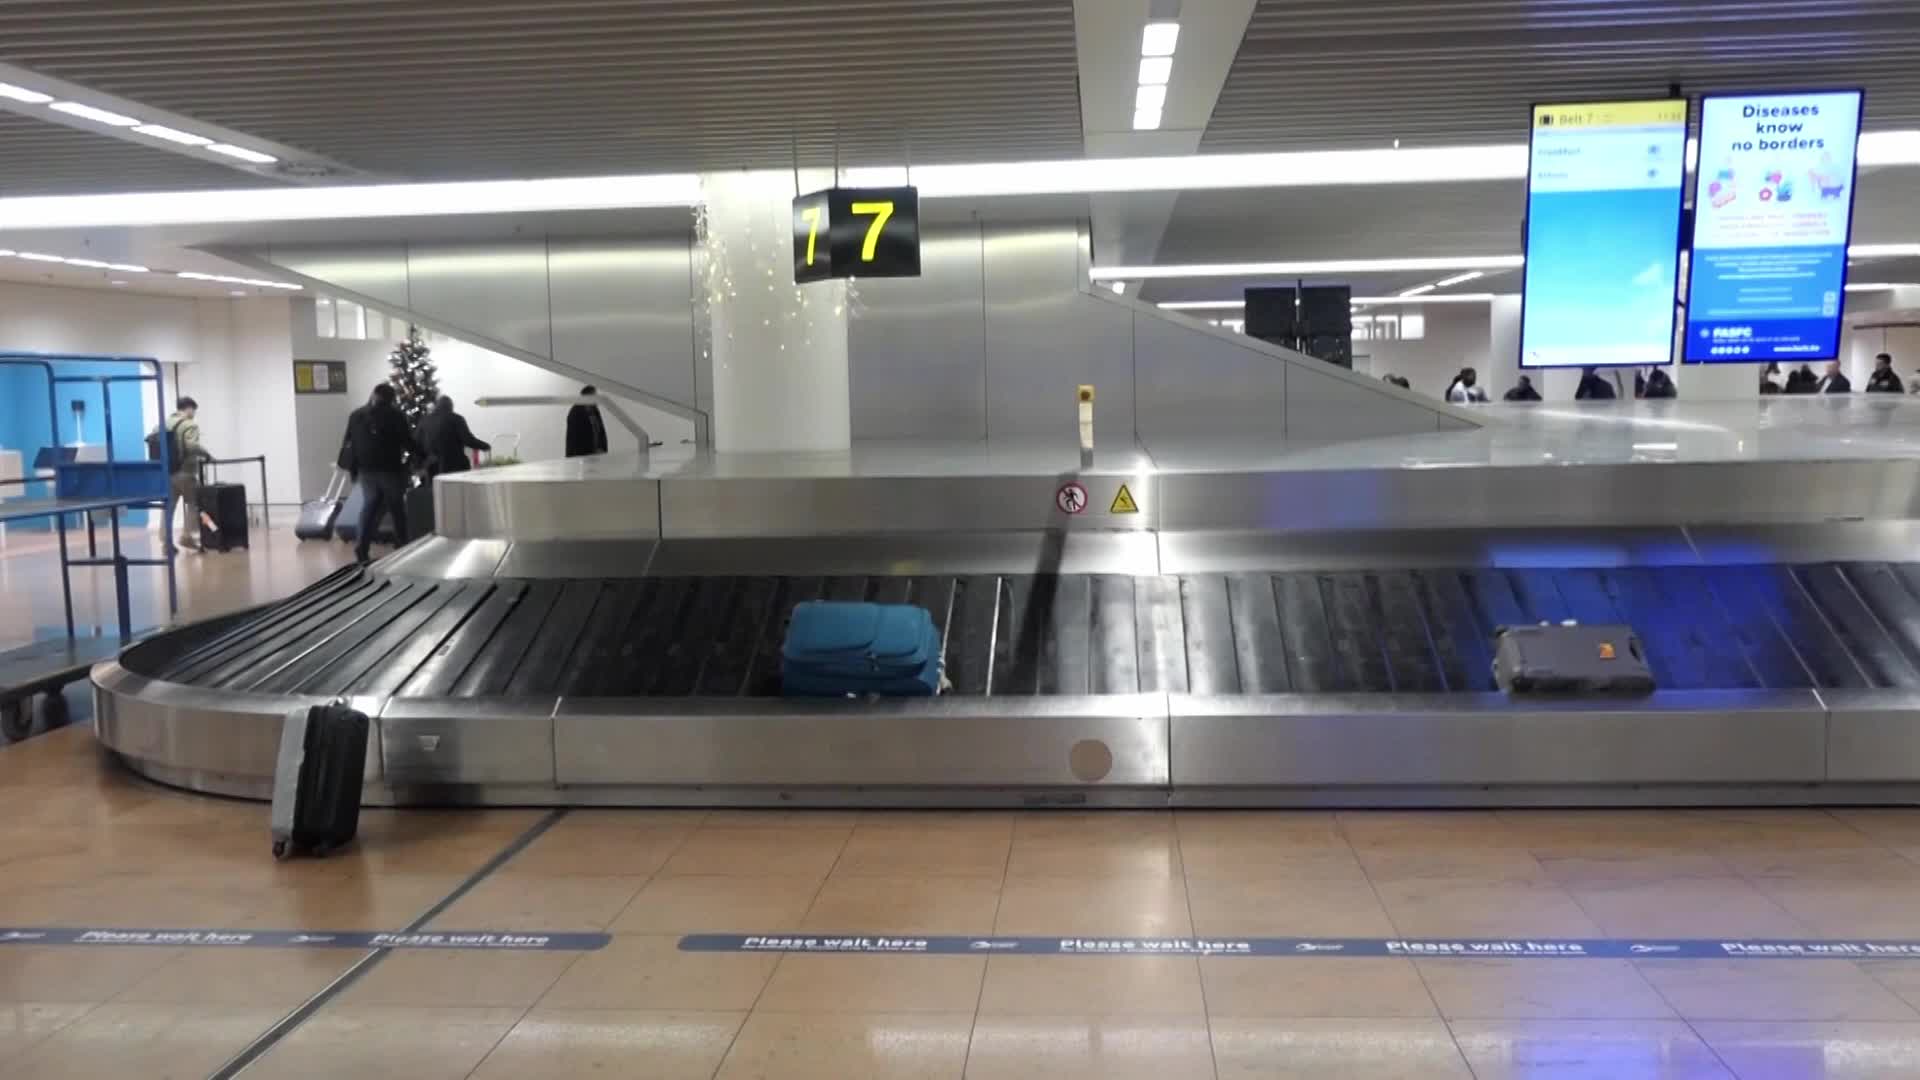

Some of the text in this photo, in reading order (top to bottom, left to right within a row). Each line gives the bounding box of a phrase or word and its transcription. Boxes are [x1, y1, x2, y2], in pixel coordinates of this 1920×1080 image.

[1743, 104, 1819, 118] Diseases
[1559, 113, 1583, 125] Belt
[1756, 121, 1803, 134] know
[1732, 137, 1824, 151] no borders
[852, 202, 893, 261] 7
[372, 933, 444, 944] Please
[743, 936, 927, 948] Please wait here
[1059, 938, 1249, 950] Please wait here
[1385, 940, 1583, 951] Please wait here
[1720, 942, 1802, 952] Please
[1807, 943, 1863, 953] wait
